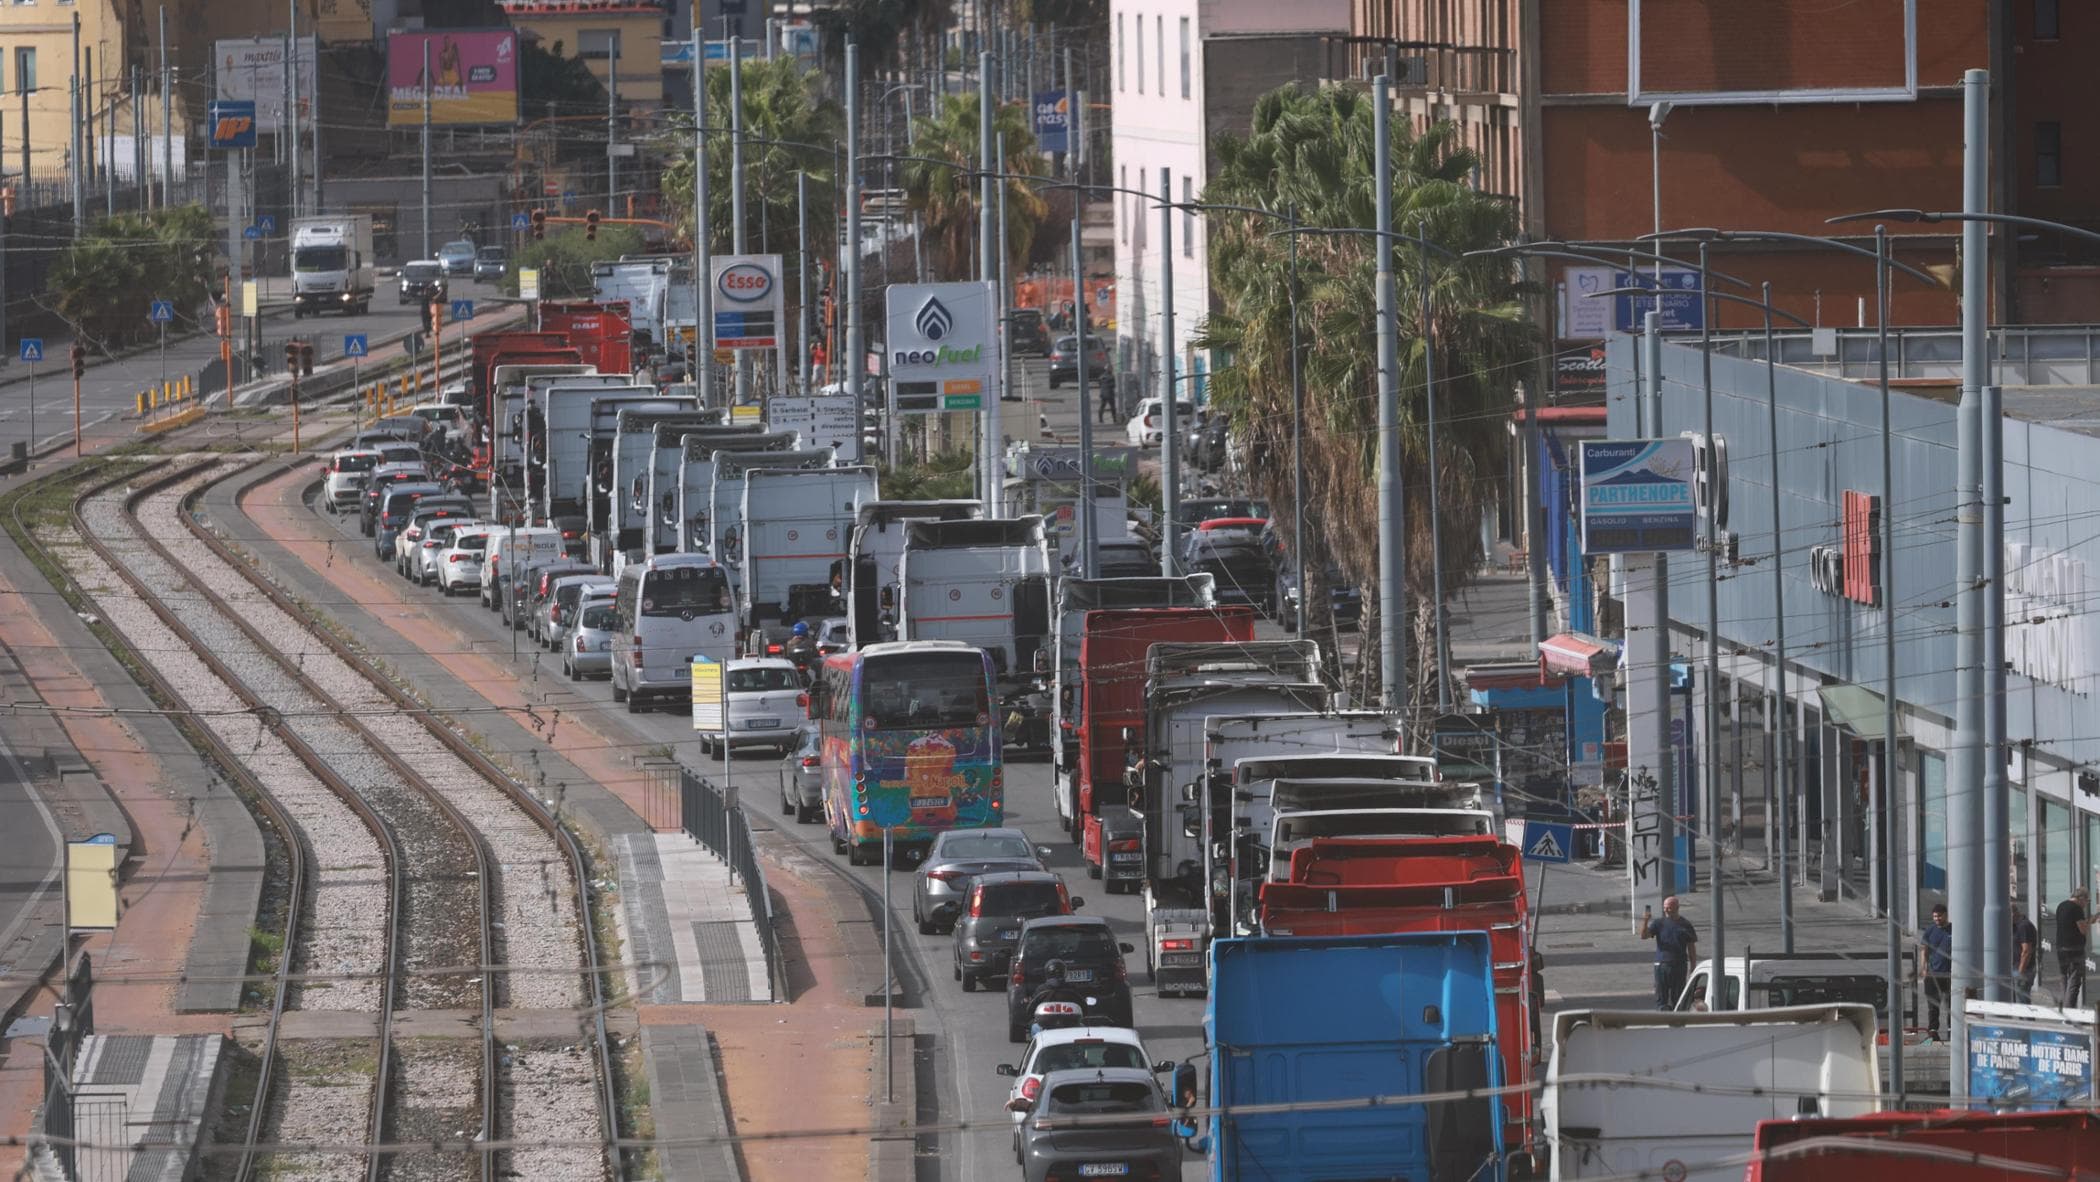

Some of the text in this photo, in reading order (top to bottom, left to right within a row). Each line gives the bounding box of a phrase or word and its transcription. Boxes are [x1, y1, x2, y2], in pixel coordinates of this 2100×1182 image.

[726, 272, 767, 289] Esso
[895, 343, 984, 368] neofuel
[1587, 448, 1636, 458] Carburanti
[1590, 483, 1688, 504] PARTHENOPE
[1590, 515, 1679, 526] GASOLIO BENZINA
[1971, 1039, 2029, 1058] NOTRE DAME
[2031, 1045, 2090, 1064] NOTRE DAME
[1977, 1054, 2020, 1070] DE PARIS
[2038, 1059, 2083, 1077] DE PARIS
